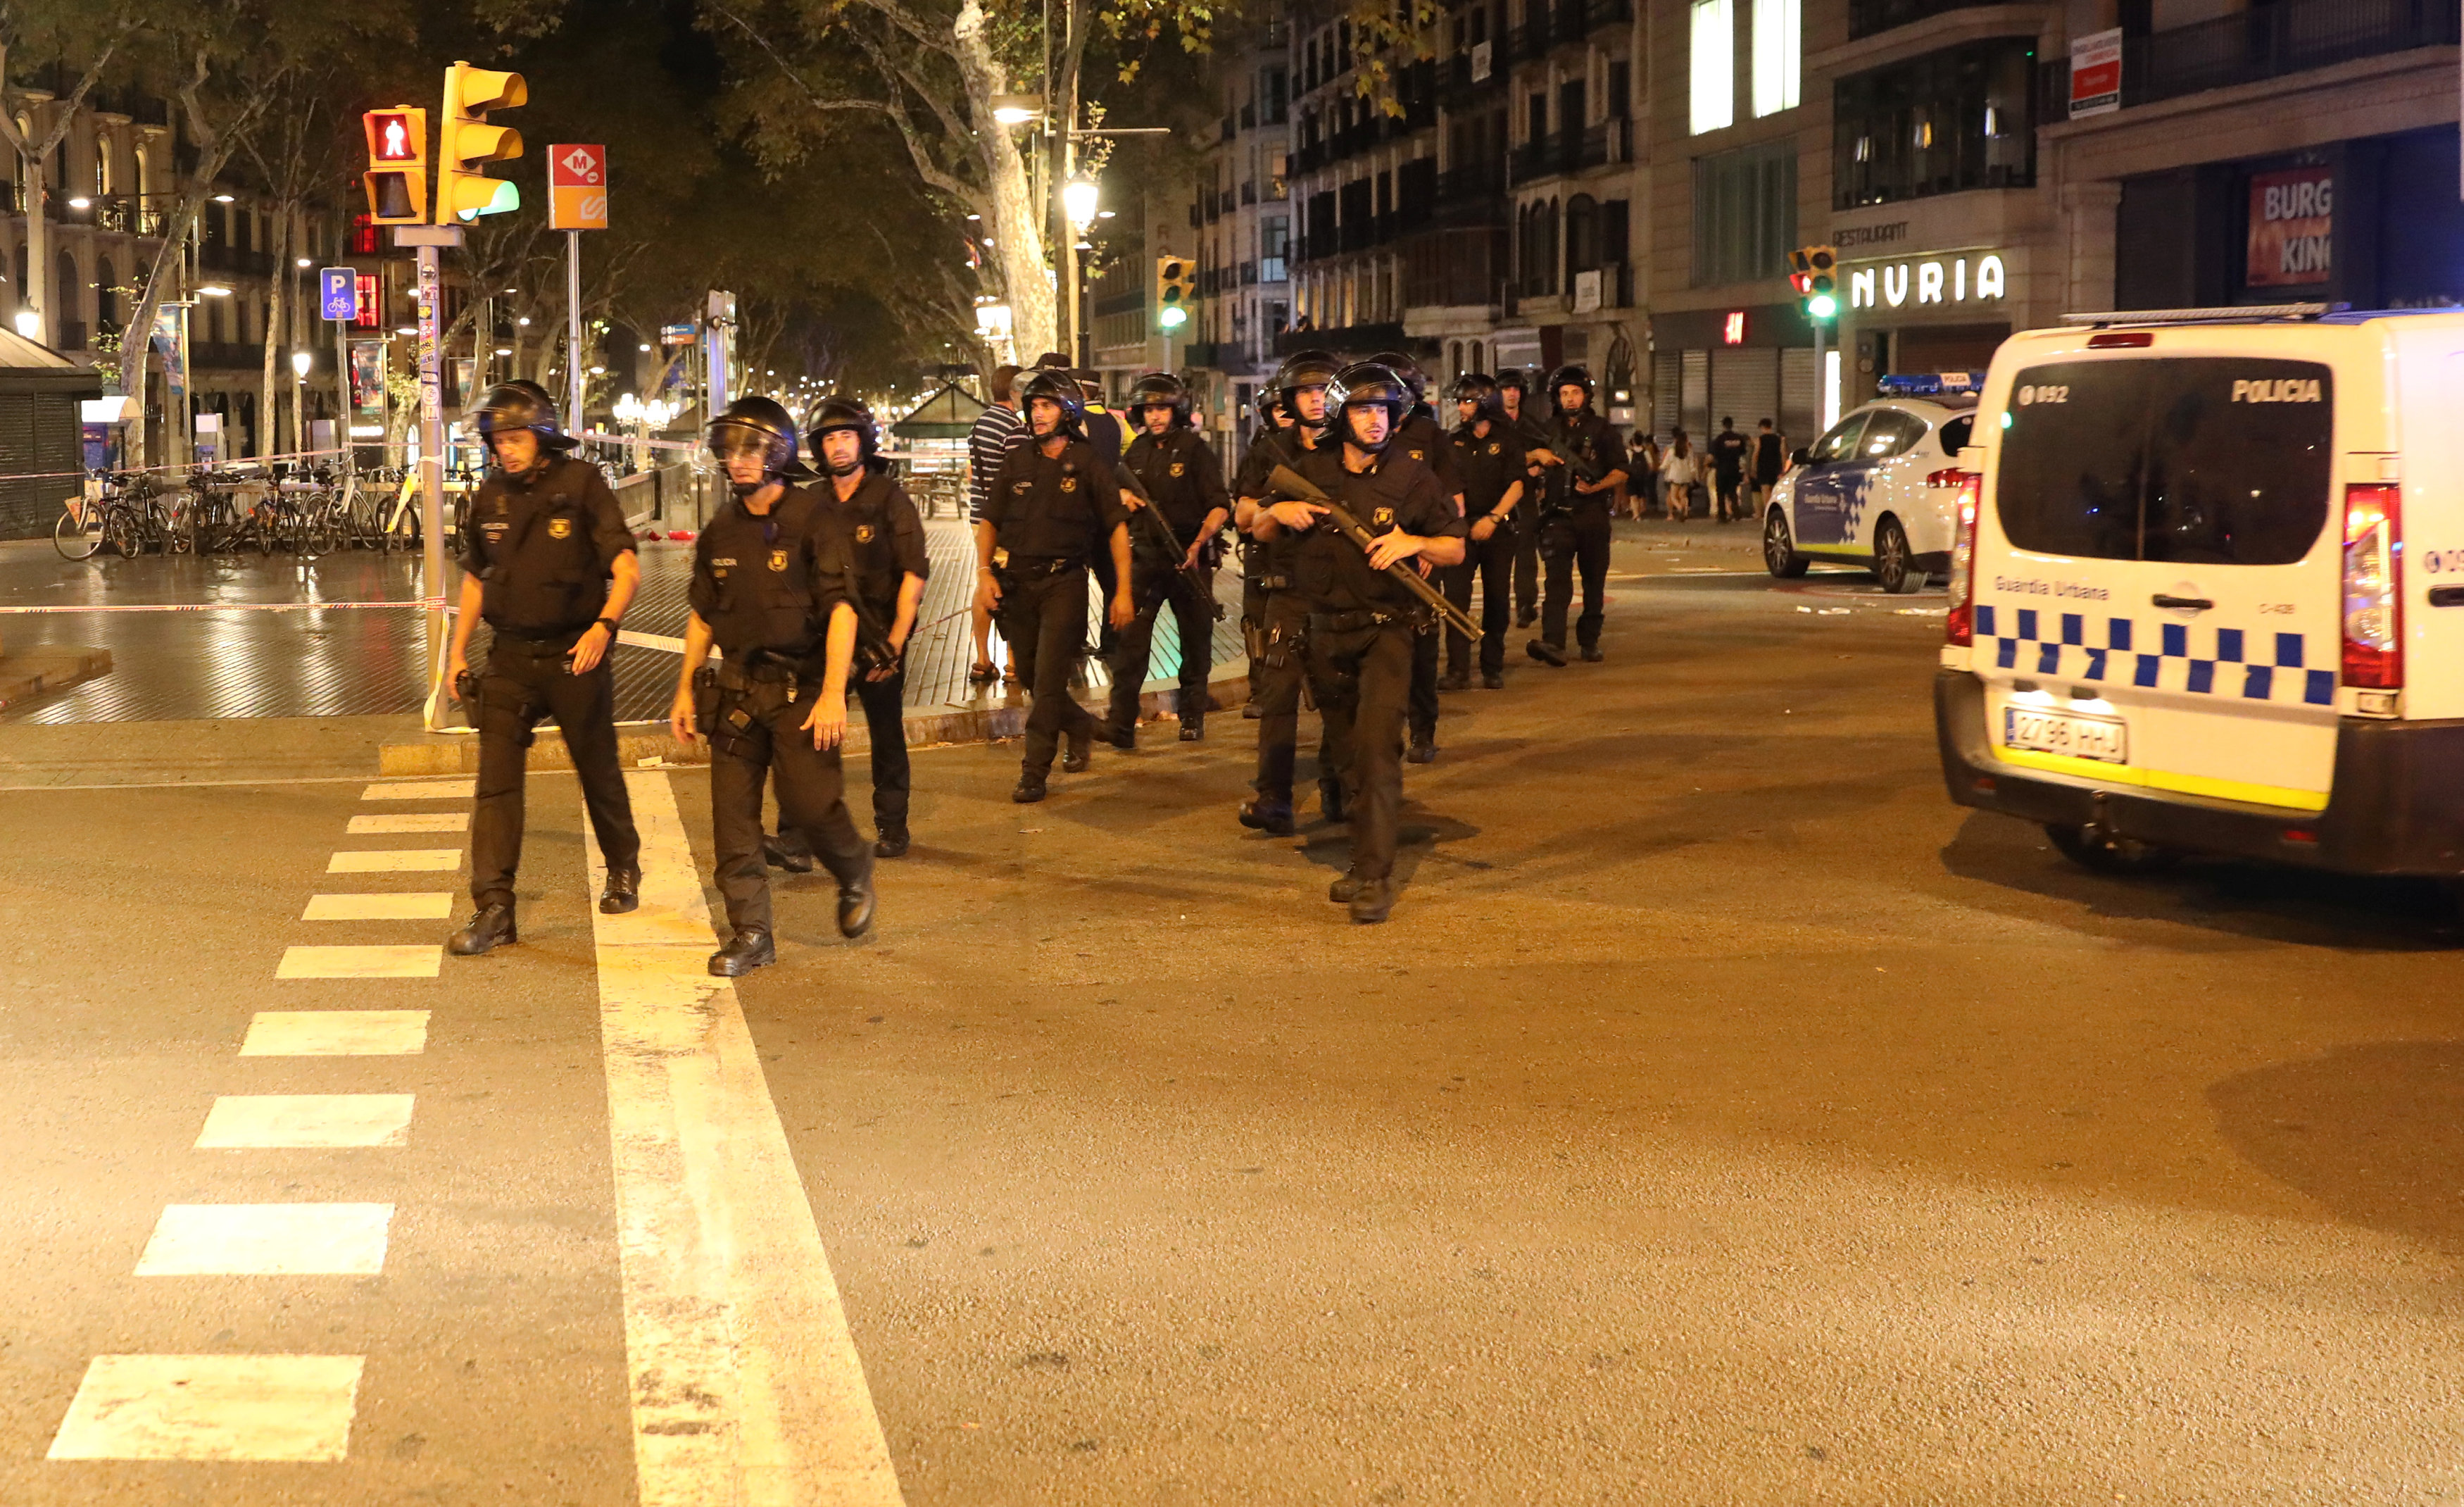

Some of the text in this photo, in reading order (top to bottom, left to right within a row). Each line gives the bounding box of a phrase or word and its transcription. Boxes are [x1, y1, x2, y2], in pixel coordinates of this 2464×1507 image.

[573, 156, 586, 169] M
[1833, 221, 1909, 247] RESTAURANT
[2280, 236, 2332, 273] KIN
[331, 275, 346, 294] P
[1852, 255, 2004, 308] NURIA
[2231, 379, 2322, 404] POLICIA
[2055, 581, 2108, 601] Urbana
